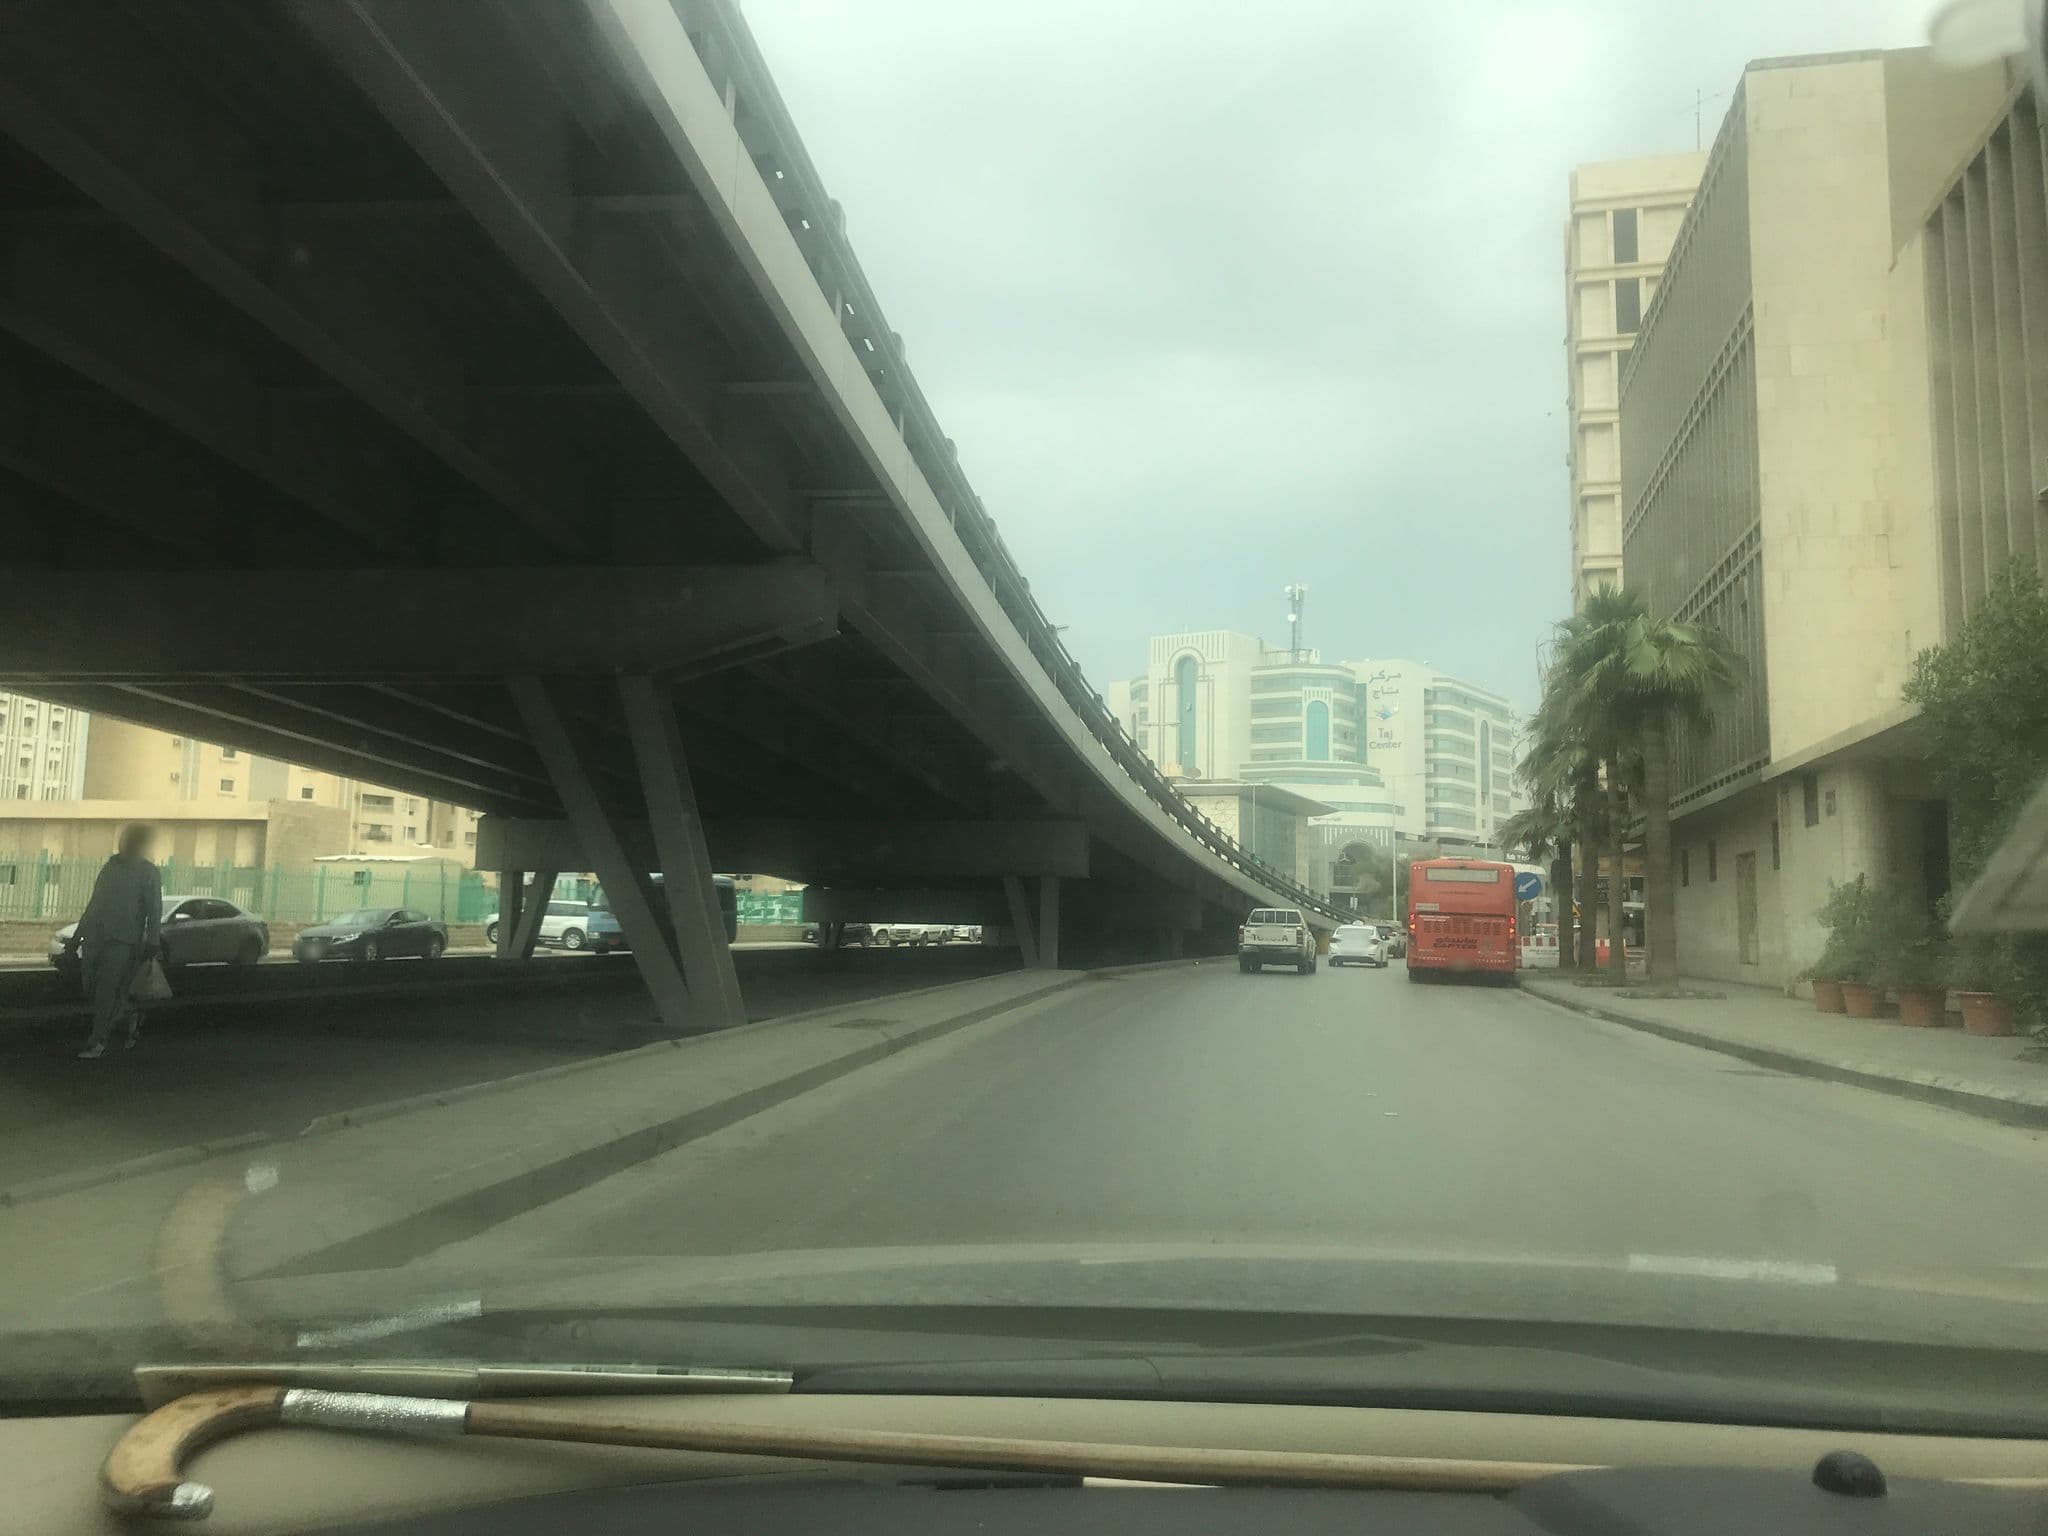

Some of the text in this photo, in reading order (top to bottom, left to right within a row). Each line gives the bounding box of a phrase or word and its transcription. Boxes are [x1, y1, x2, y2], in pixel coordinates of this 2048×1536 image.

[1369, 670, 1401, 683] مركز
[1378, 728, 1392, 740] Taj
[1369, 741, 1401, 750] Center
